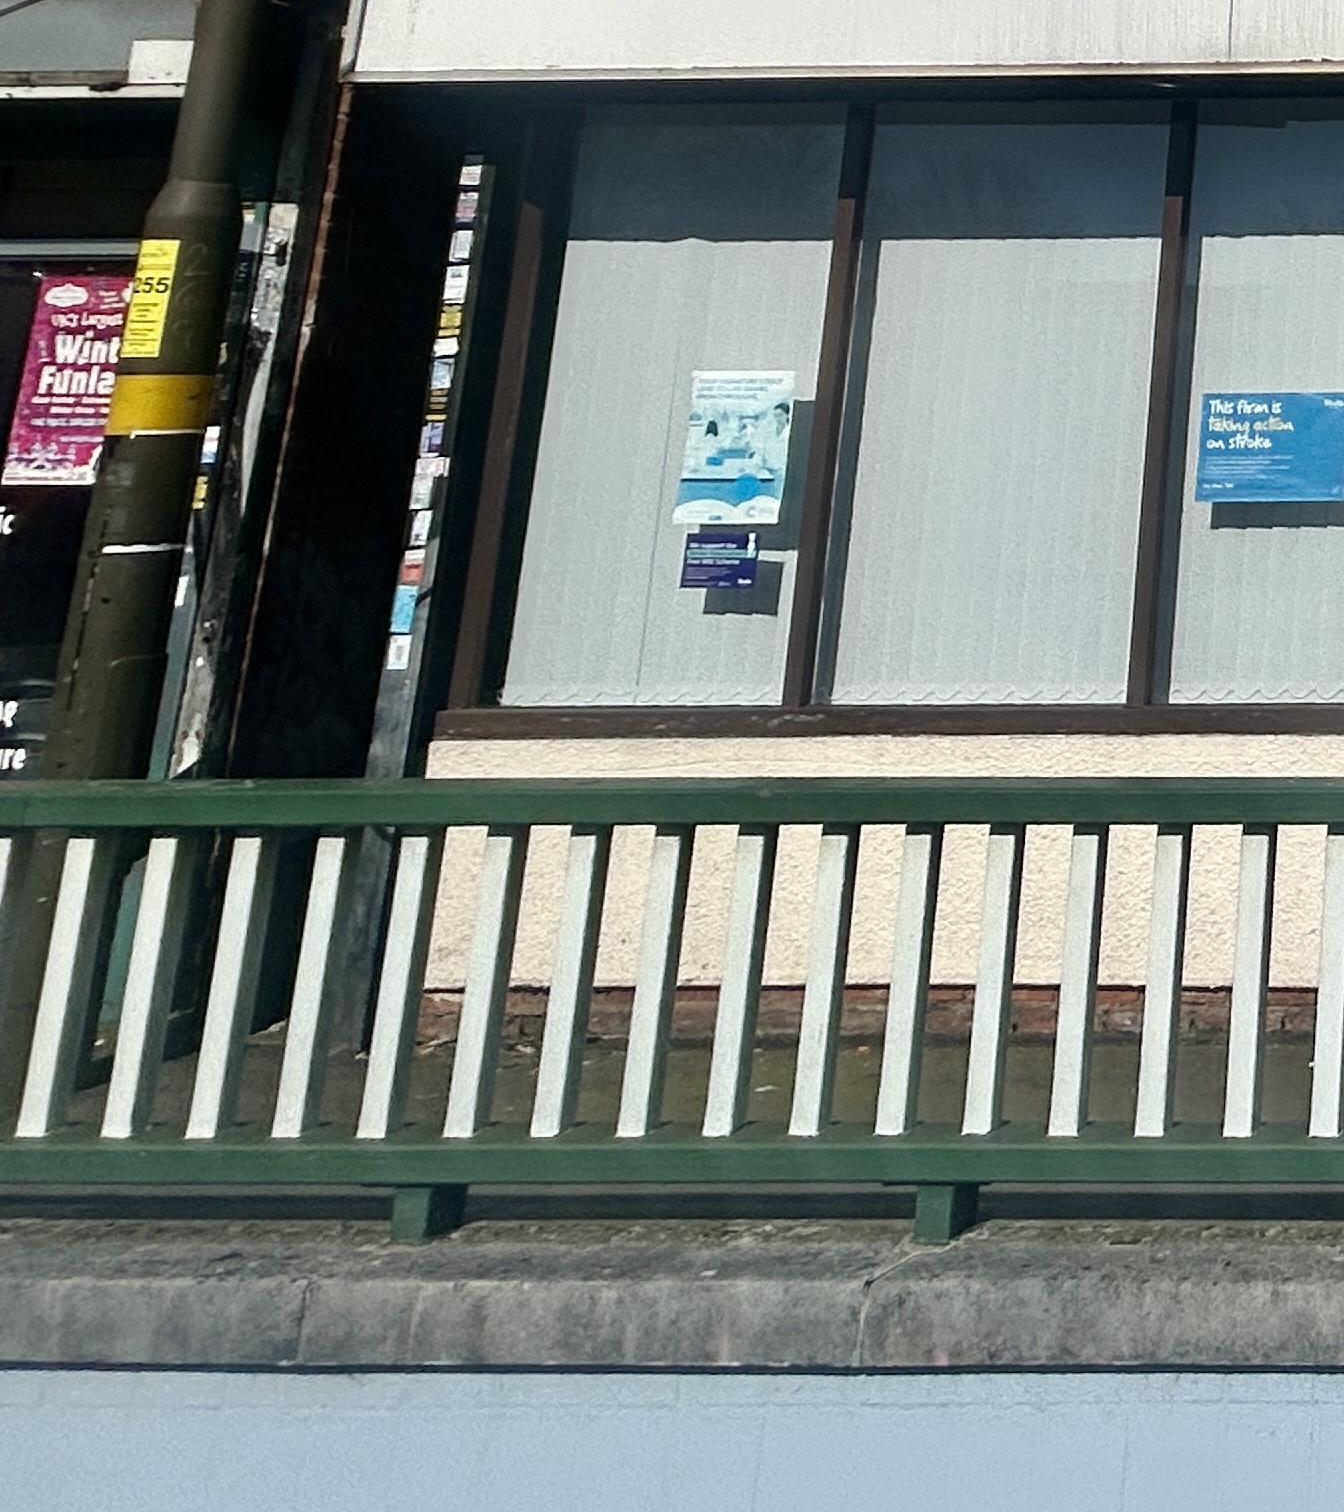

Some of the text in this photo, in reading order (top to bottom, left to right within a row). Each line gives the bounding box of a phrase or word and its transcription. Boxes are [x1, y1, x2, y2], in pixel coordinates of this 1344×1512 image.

[1209, 399, 1282, 415] This firm is
[1206, 432, 1272, 449] on stroke
